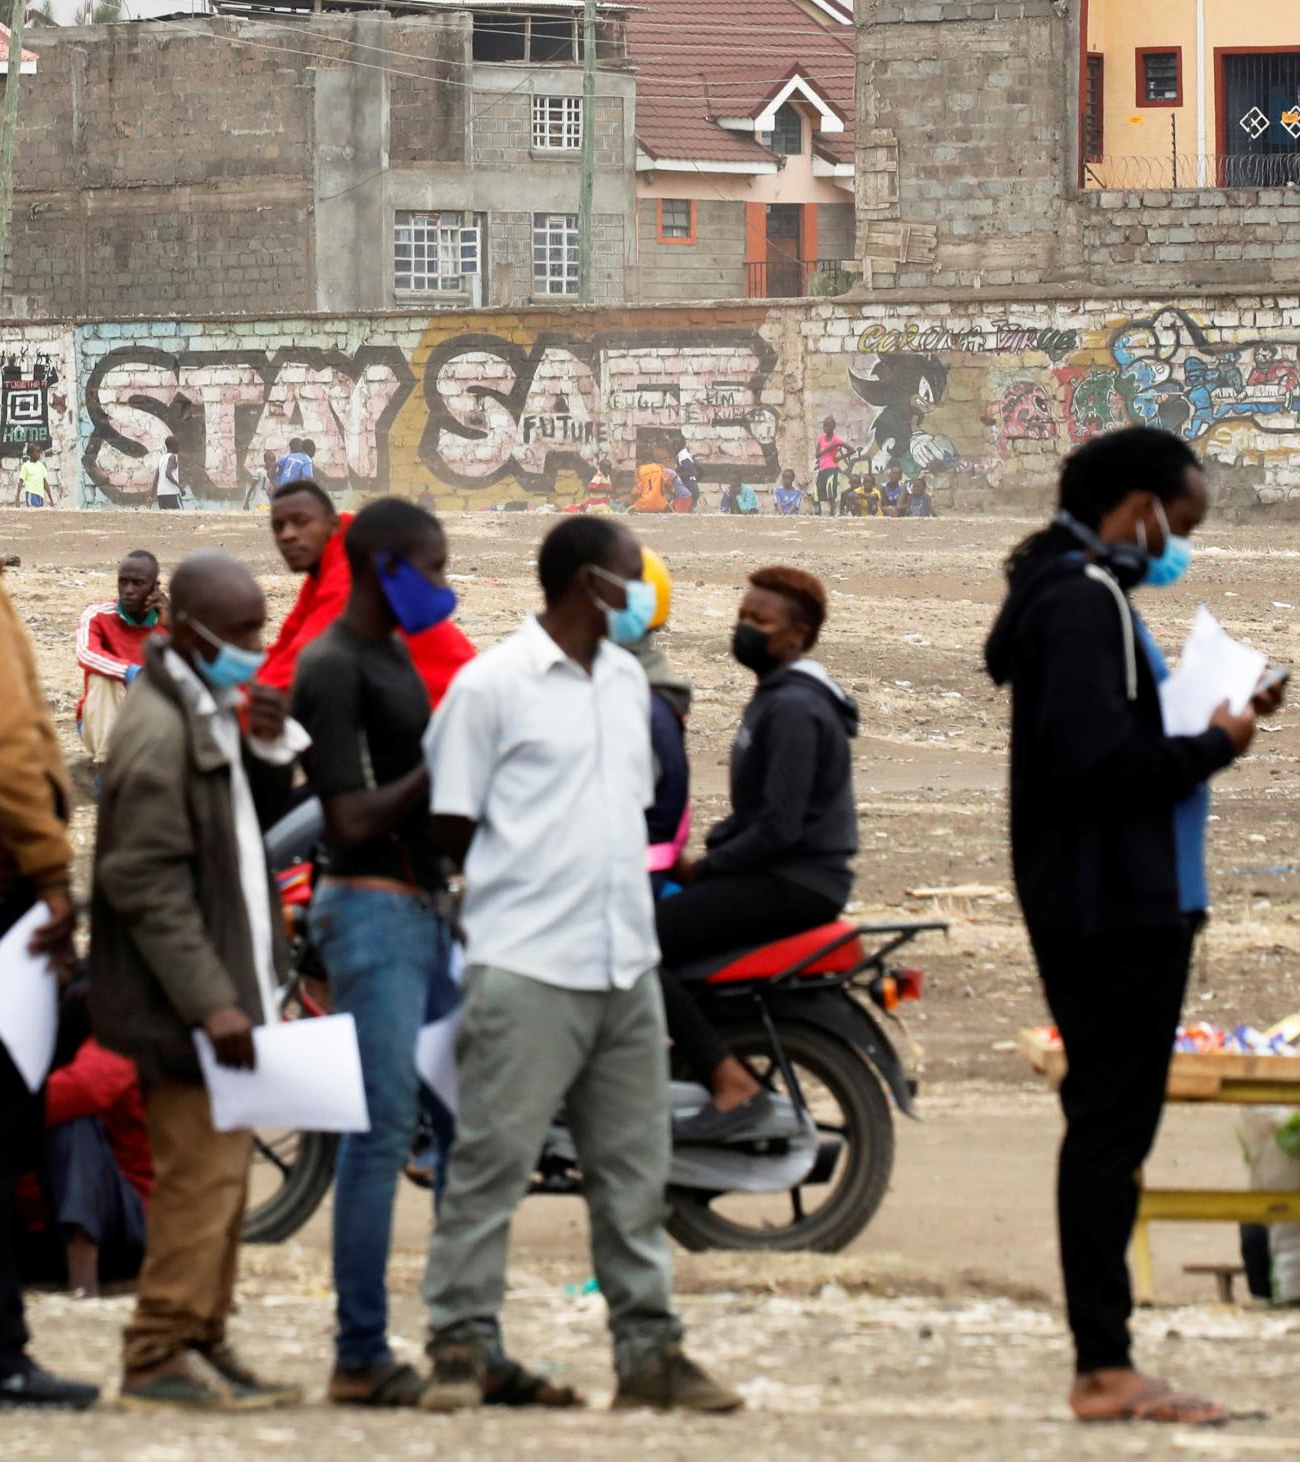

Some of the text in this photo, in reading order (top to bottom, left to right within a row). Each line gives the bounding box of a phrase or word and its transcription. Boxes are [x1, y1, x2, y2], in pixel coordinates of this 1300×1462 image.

[90, 345, 774, 495] STAY SAFE
[523, 415, 608, 444] FUTURE
